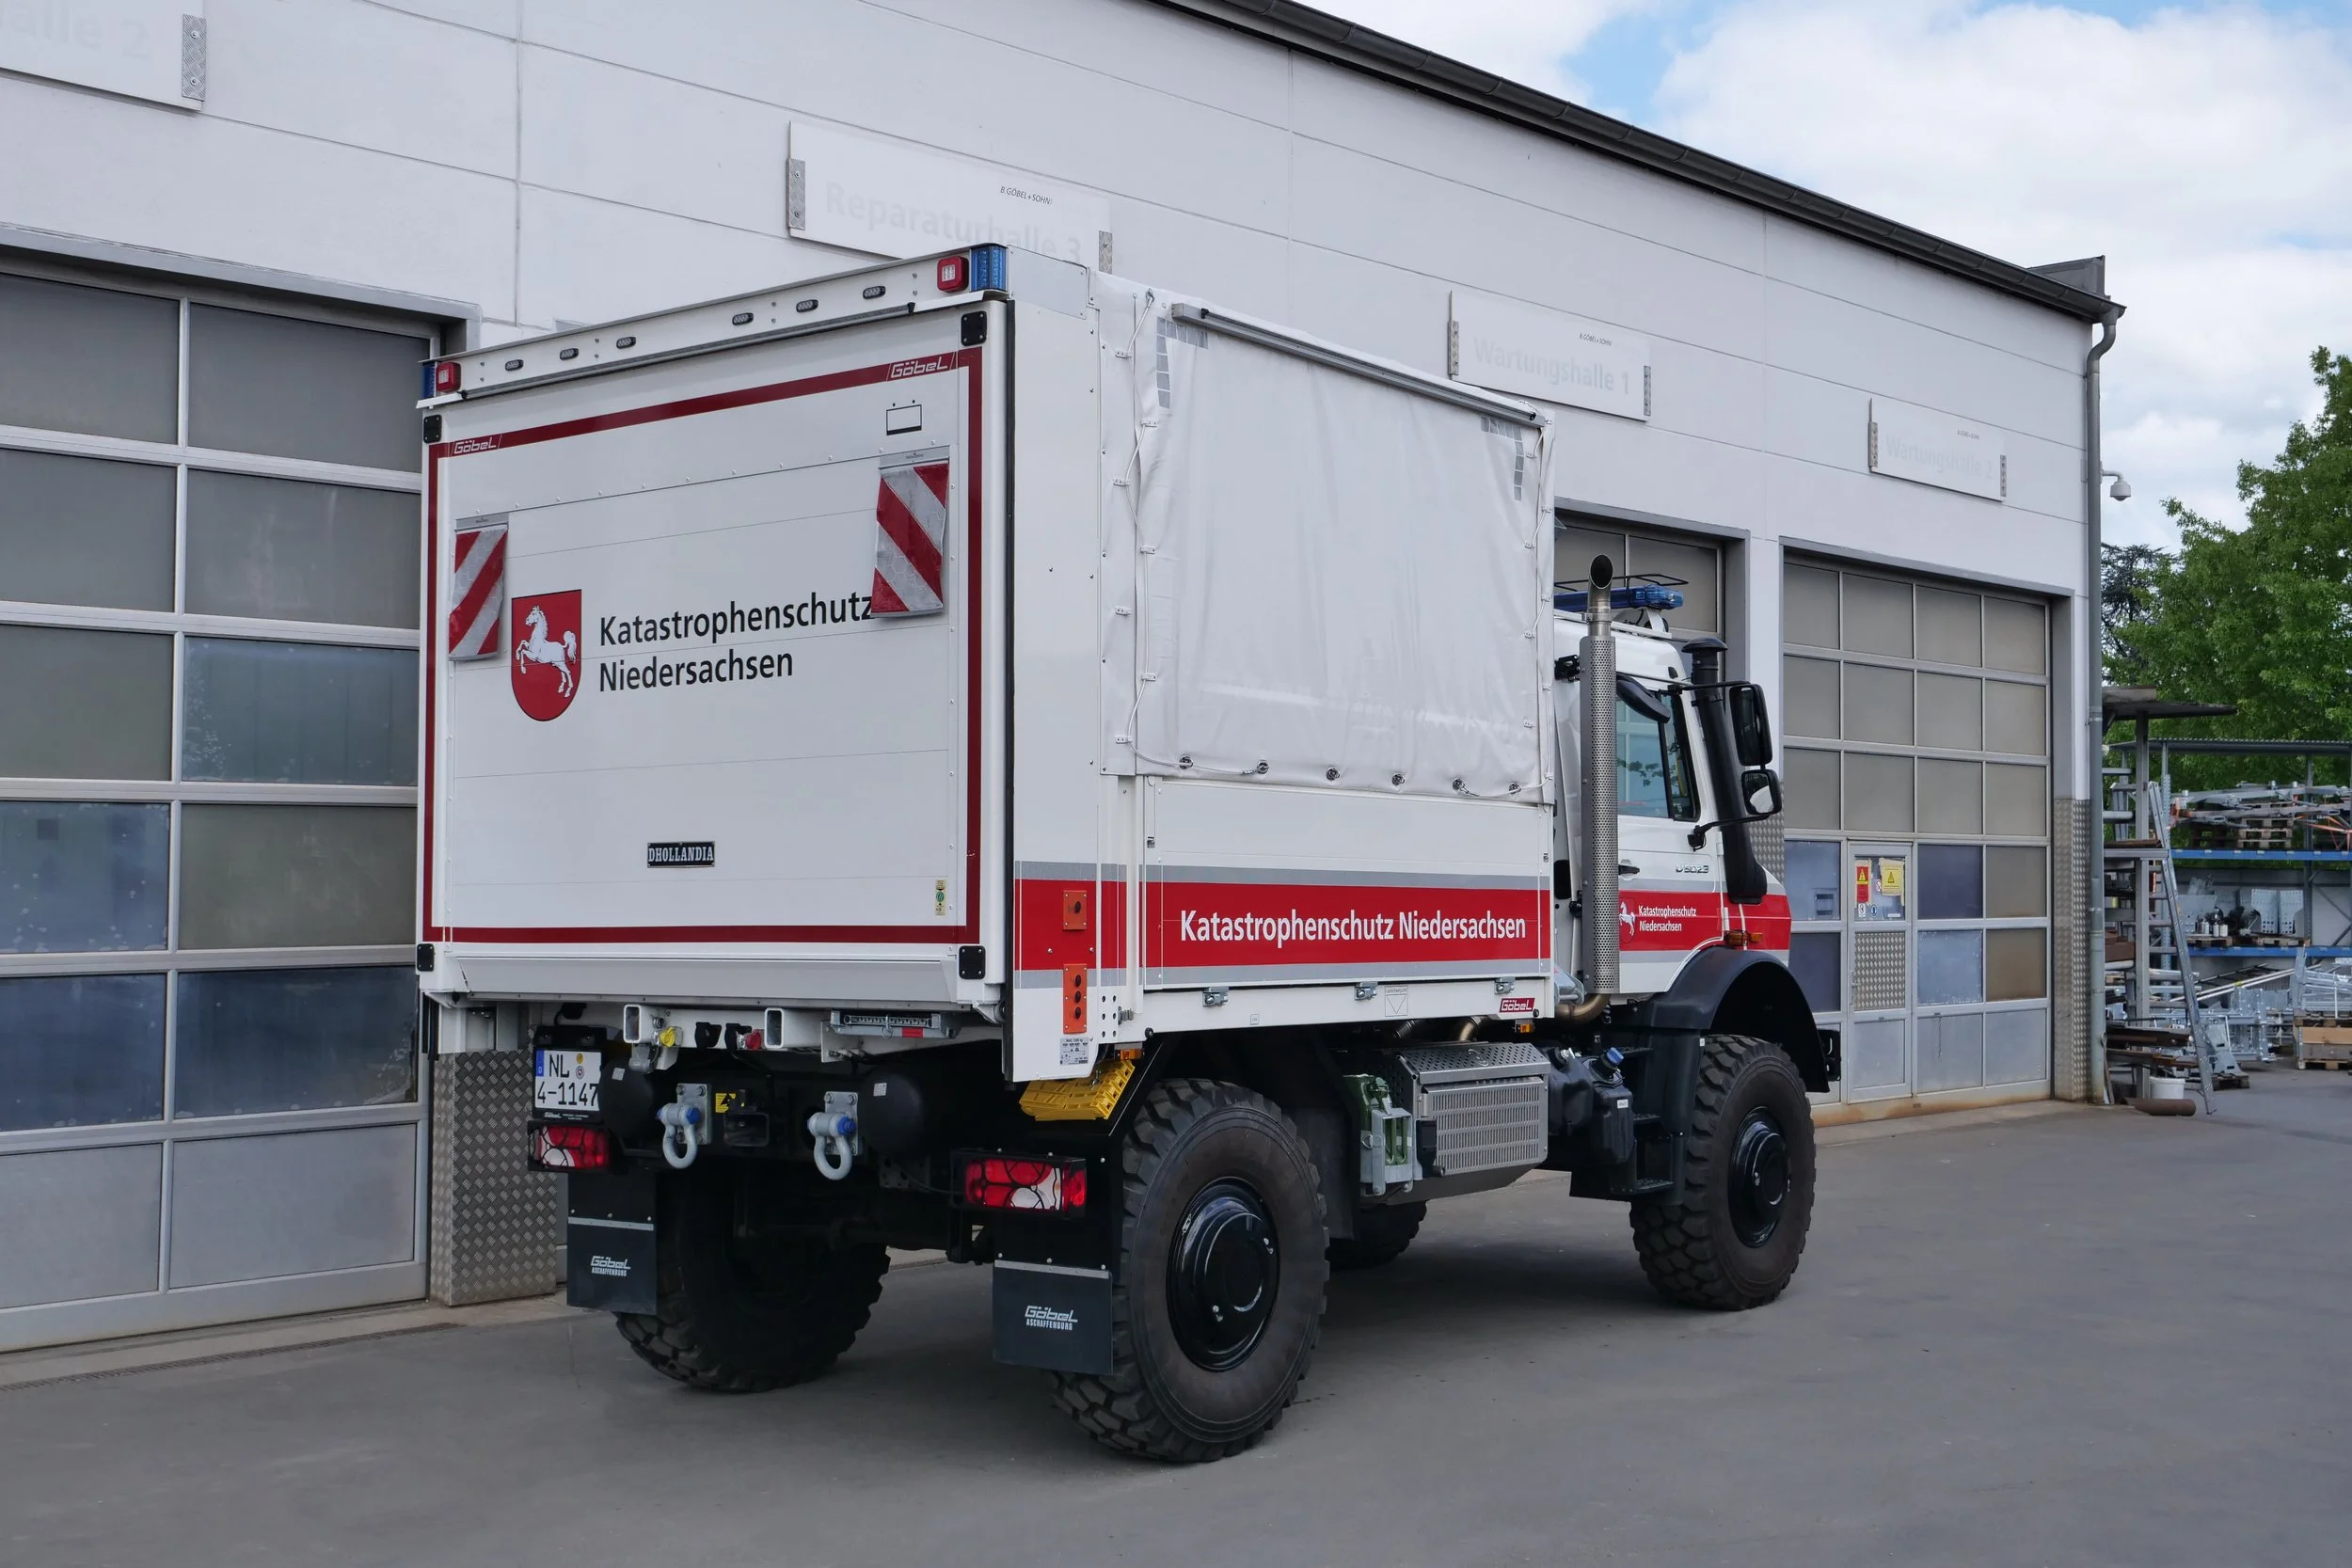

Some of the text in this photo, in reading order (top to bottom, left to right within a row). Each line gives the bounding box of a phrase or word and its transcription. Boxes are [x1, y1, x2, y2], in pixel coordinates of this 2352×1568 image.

[120, 17, 151, 60] 2
[1473, 336, 1629, 395] Wartungshalle 1
[1886, 434, 1982, 478] Wartungshalle
[599, 592, 875, 646] Katastrophenschutz
[599, 648, 793, 692] Niedersachsen
[648, 846, 714, 863] DHOLLANDIA
[1638, 904, 1697, 919] Katastrophenschutz
[1639, 919, 1682, 932] Niedersachsen
[1181, 909, 1526, 949] Katastrophenschutz Niedersachsen
[548, 1053, 570, 1078] NL
[537, 1081, 599, 1107] 4-1147
[1025, 1318, 1073, 1331] ASCHAFFENBURG
